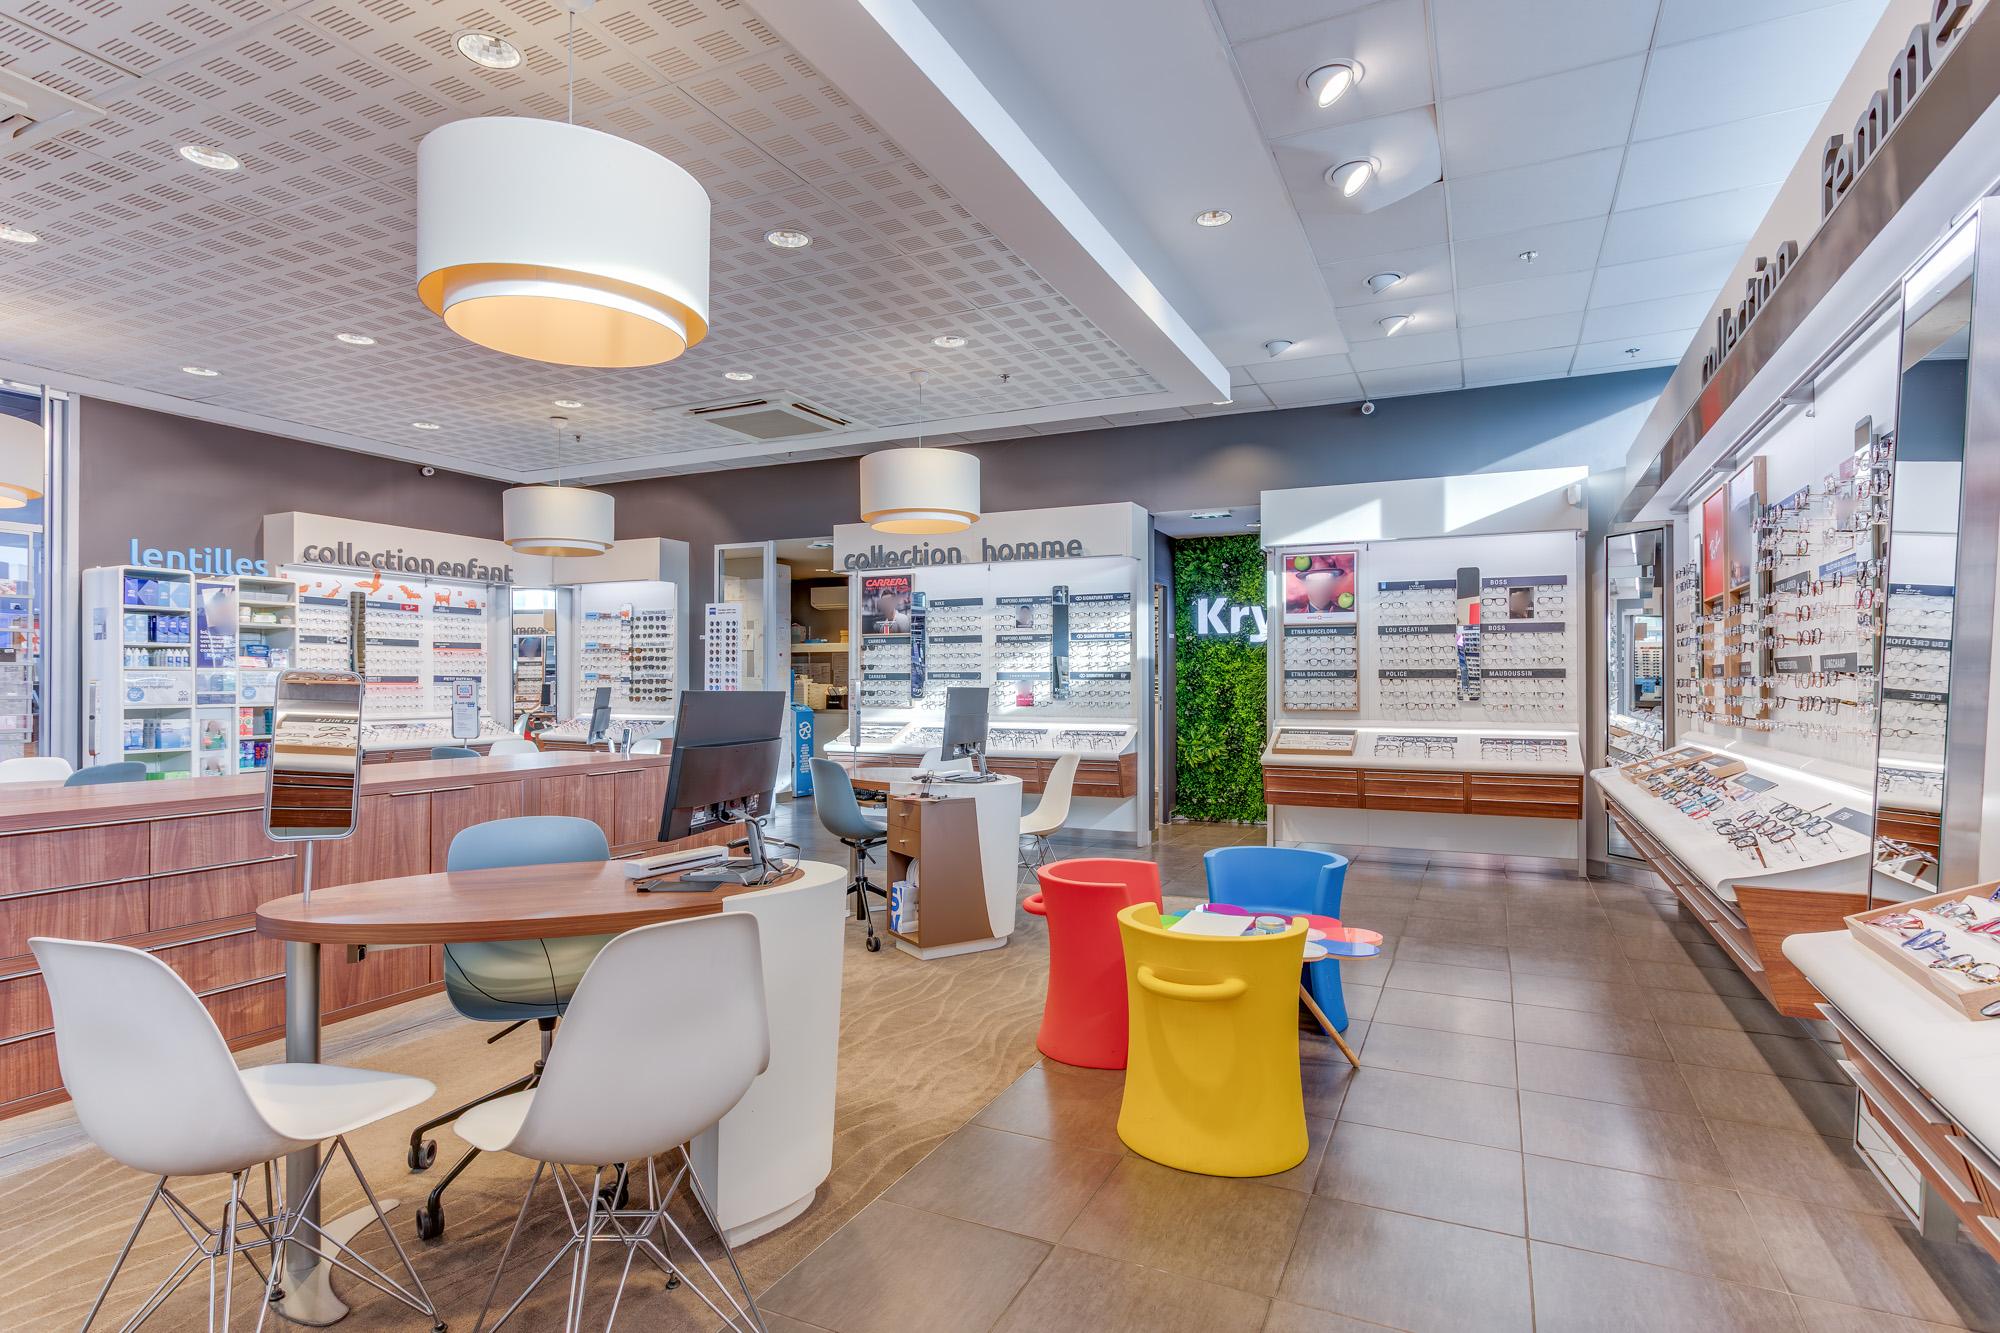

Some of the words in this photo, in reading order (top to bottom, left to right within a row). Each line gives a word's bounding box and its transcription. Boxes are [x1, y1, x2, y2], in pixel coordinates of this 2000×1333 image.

[1821, 0, 1972, 224] femme
[130, 538, 269, 577] lentilles
[844, 542, 961, 570] collection
[982, 538, 1083, 561] homme
[865, 577, 908, 587] CARRERA
[1399, 625, 1429, 633] CRÉATION
